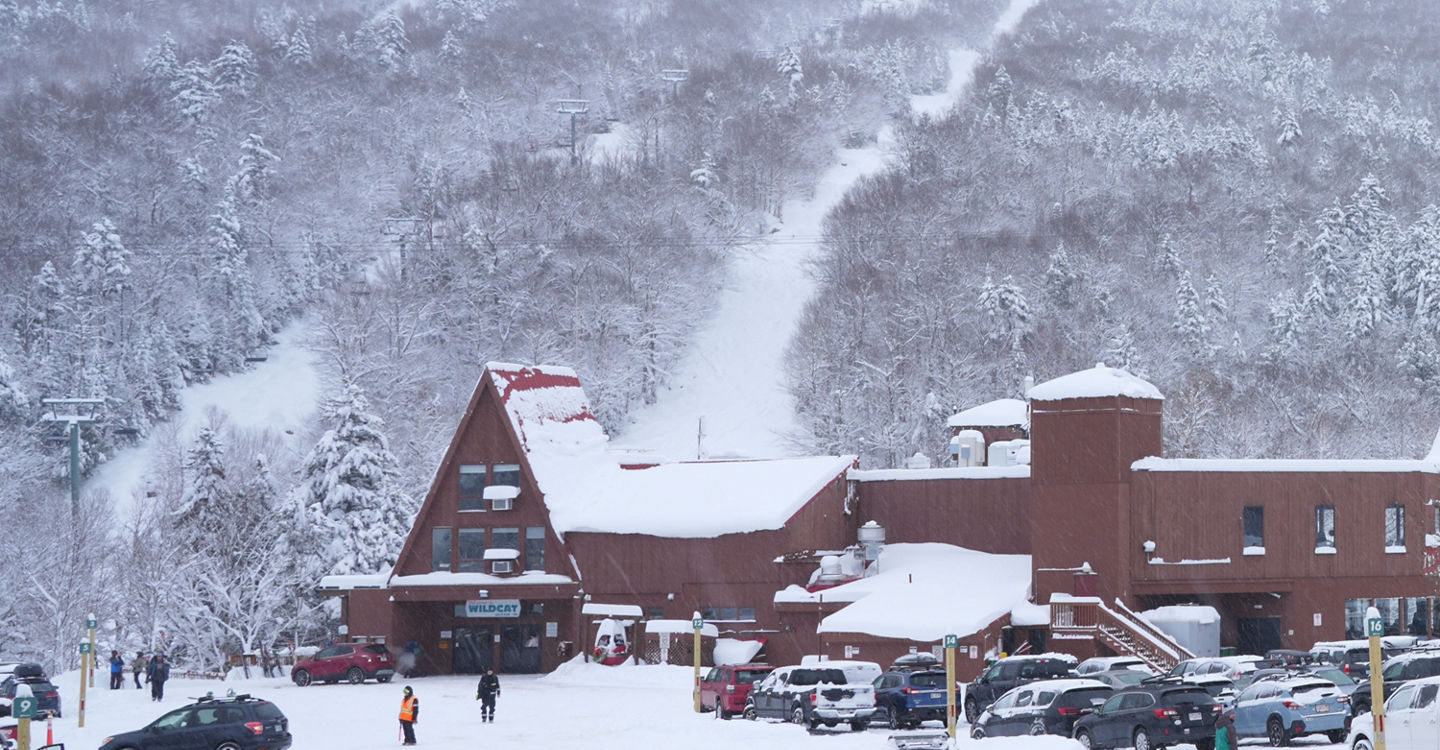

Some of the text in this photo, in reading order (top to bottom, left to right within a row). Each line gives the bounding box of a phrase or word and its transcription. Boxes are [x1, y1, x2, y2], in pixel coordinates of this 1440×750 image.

[468, 604, 518, 612] WILDCAT
[1370, 620, 1382, 632] 16
[946, 636, 956, 645] 14
[20, 700, 31, 712] 9
